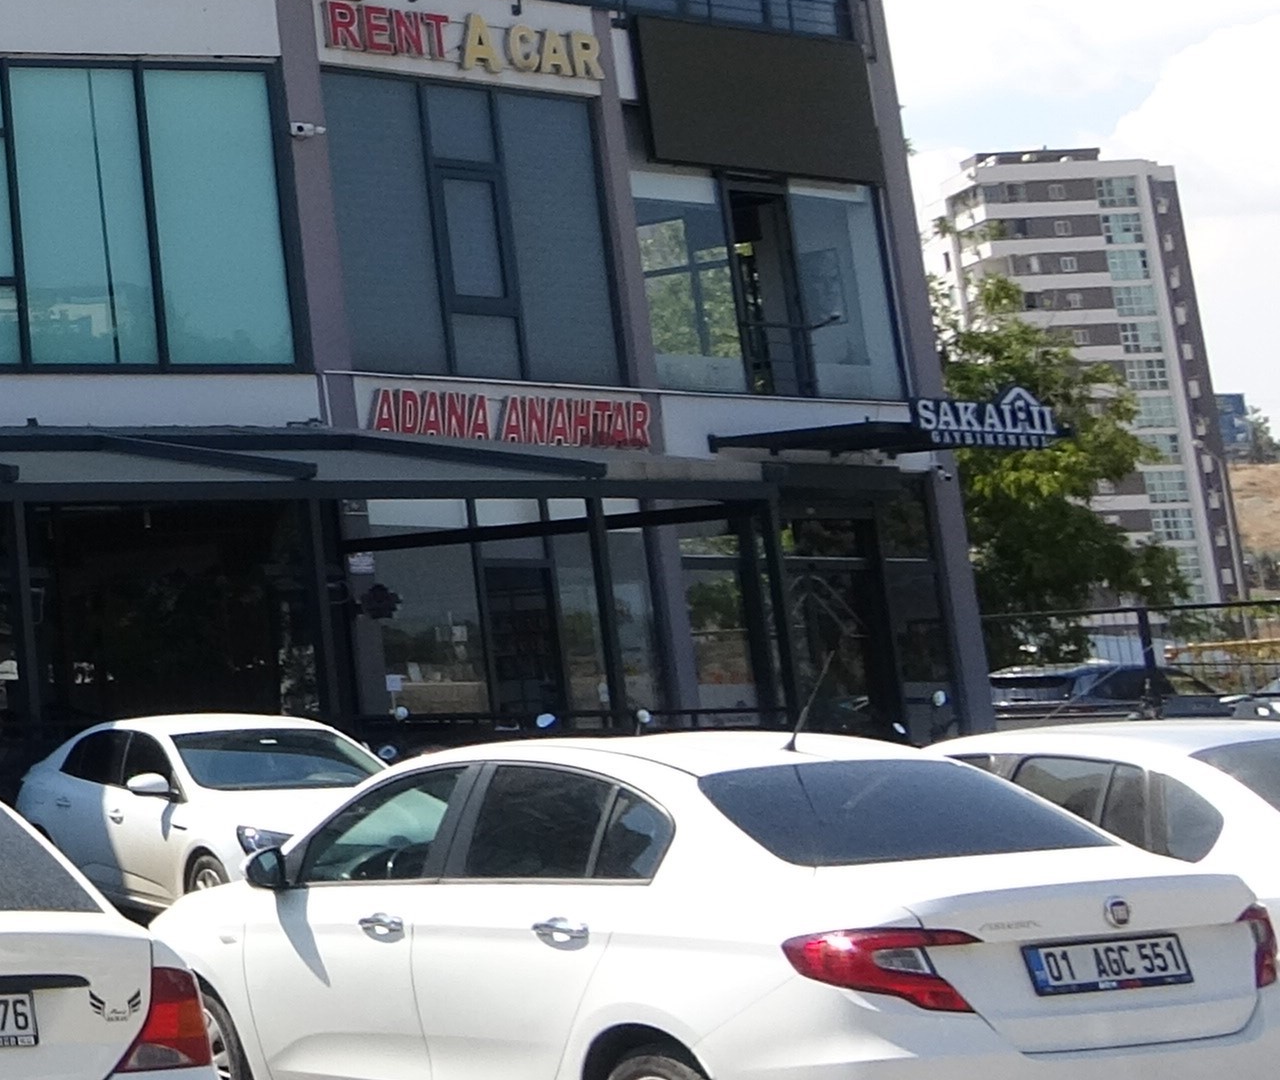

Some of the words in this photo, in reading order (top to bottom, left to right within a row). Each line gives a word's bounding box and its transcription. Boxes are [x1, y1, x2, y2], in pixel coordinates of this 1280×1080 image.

[327, 0, 449, 59] RENT
[462, 13, 503, 73] A
[509, 24, 605, 80] CAR
[373, 388, 490, 440] ADANA
[502, 395, 651, 448] ANAHTAR
[1045, 950, 1077, 982] 01
[1093, 945, 1135, 978] AGC
[1138, 941, 1181, 972] 551
